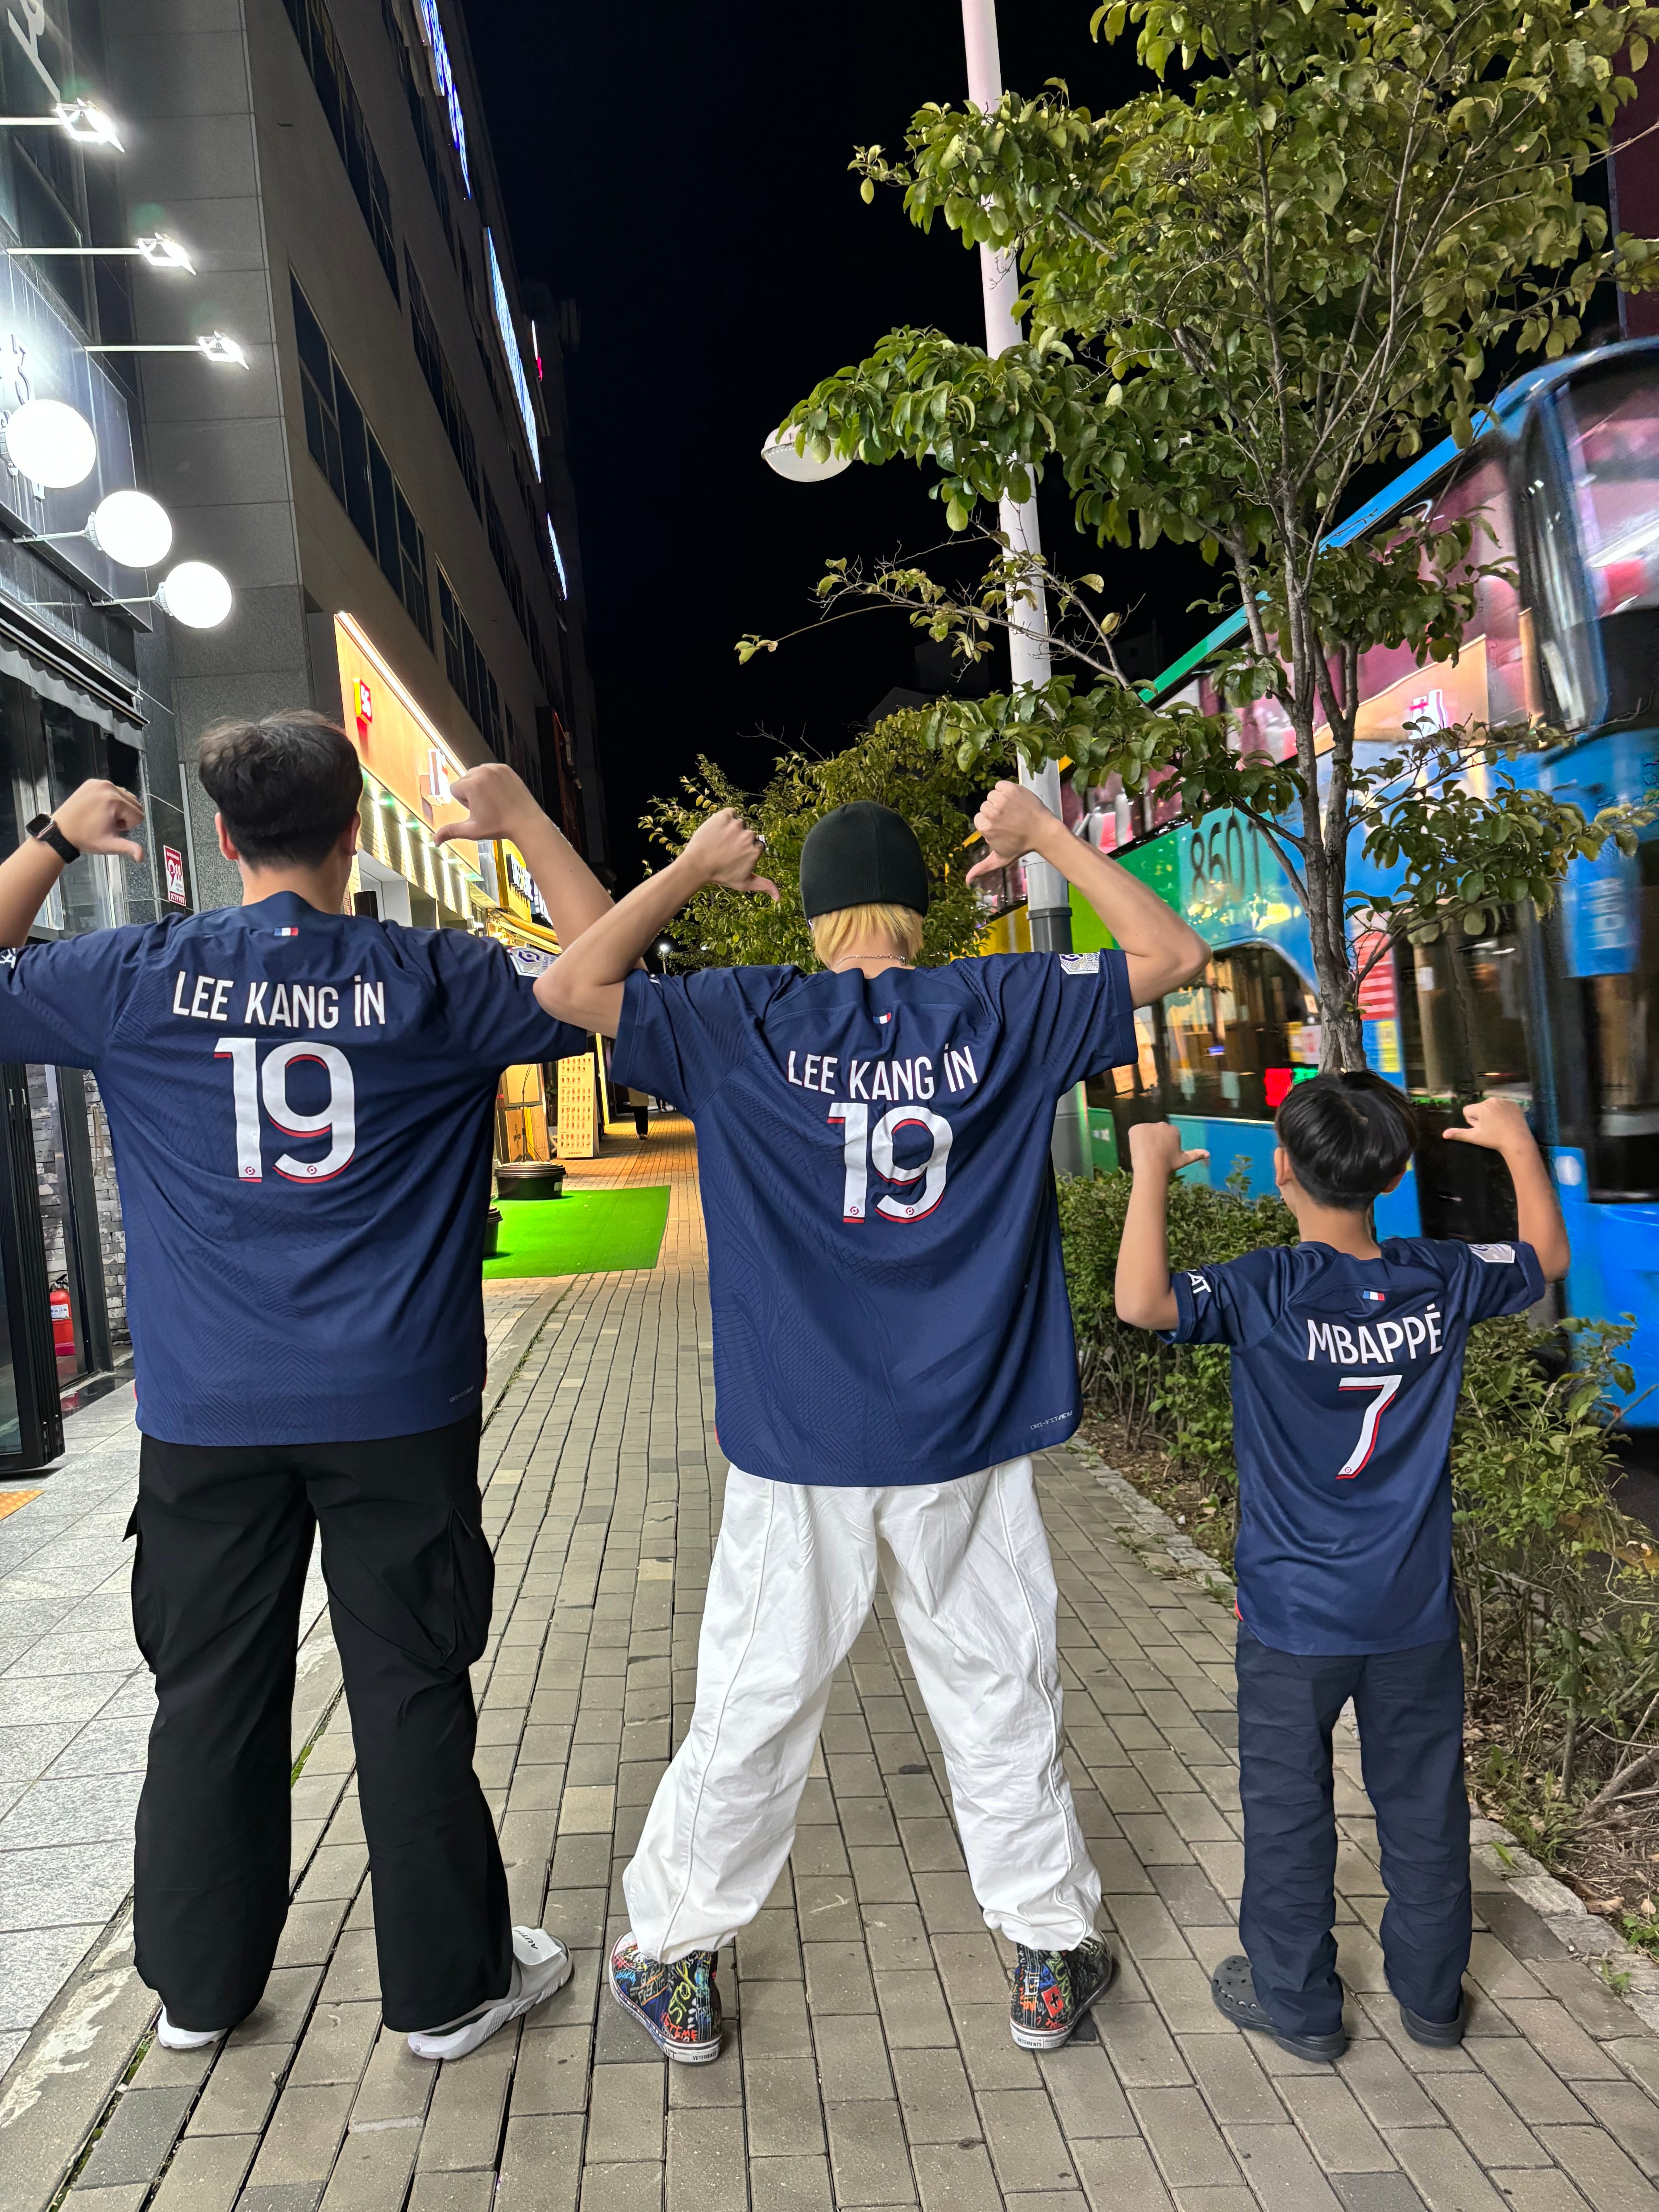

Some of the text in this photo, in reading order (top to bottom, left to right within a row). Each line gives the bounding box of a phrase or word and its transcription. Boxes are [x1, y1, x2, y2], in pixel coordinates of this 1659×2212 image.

[172, 971, 234, 1021] LEE
[244, 981, 339, 1029] KANG
[787, 1050, 838, 1095] LEE
[849, 1056, 935, 1101] KANG
[214, 1037, 356, 1183] 19
[827, 1103, 953, 1223] 19
[1307, 1303, 1443, 1364] MBAPPÉ
[1336, 1374, 1403, 1479] 7
[1017, 2036, 1042, 2047] VETEMENTS
